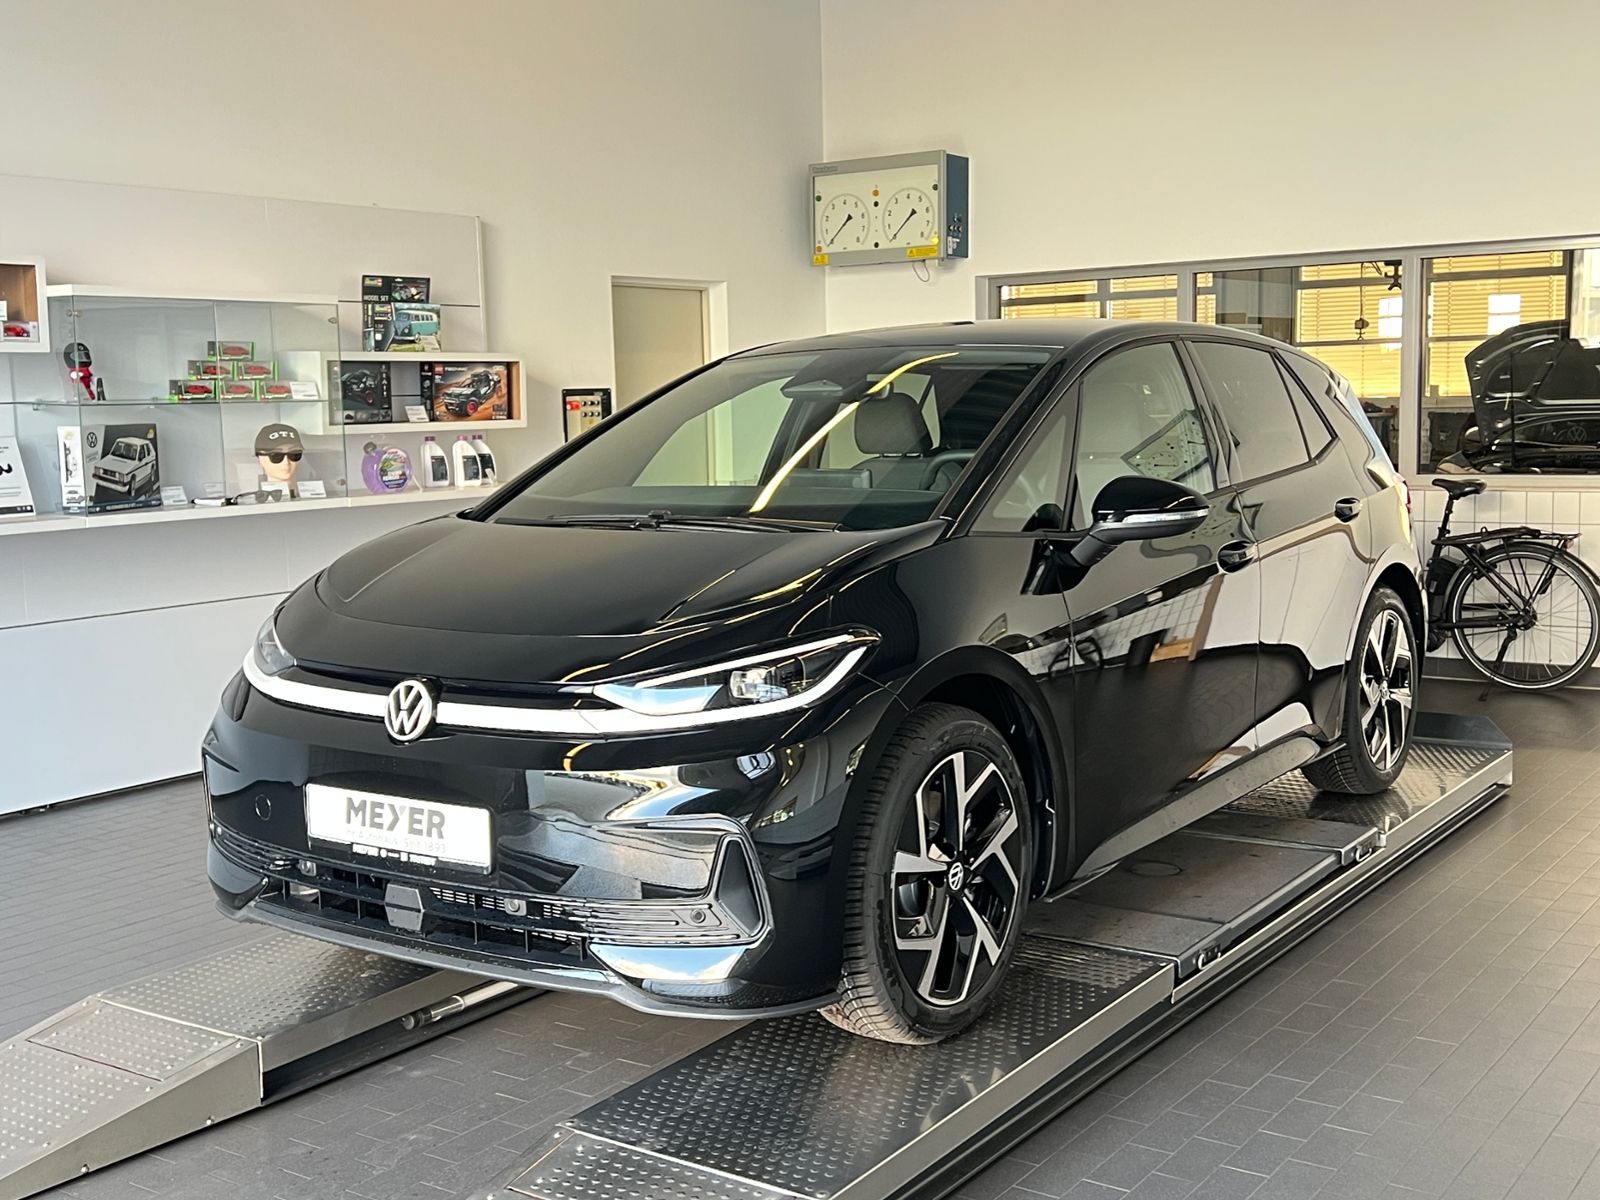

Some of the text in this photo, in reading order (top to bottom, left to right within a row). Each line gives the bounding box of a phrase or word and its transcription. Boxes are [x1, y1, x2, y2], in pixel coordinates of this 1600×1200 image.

[268, 431, 295, 440] GTI
[384, 679, 433, 741] VW
[345, 797, 446, 840] MEYER
